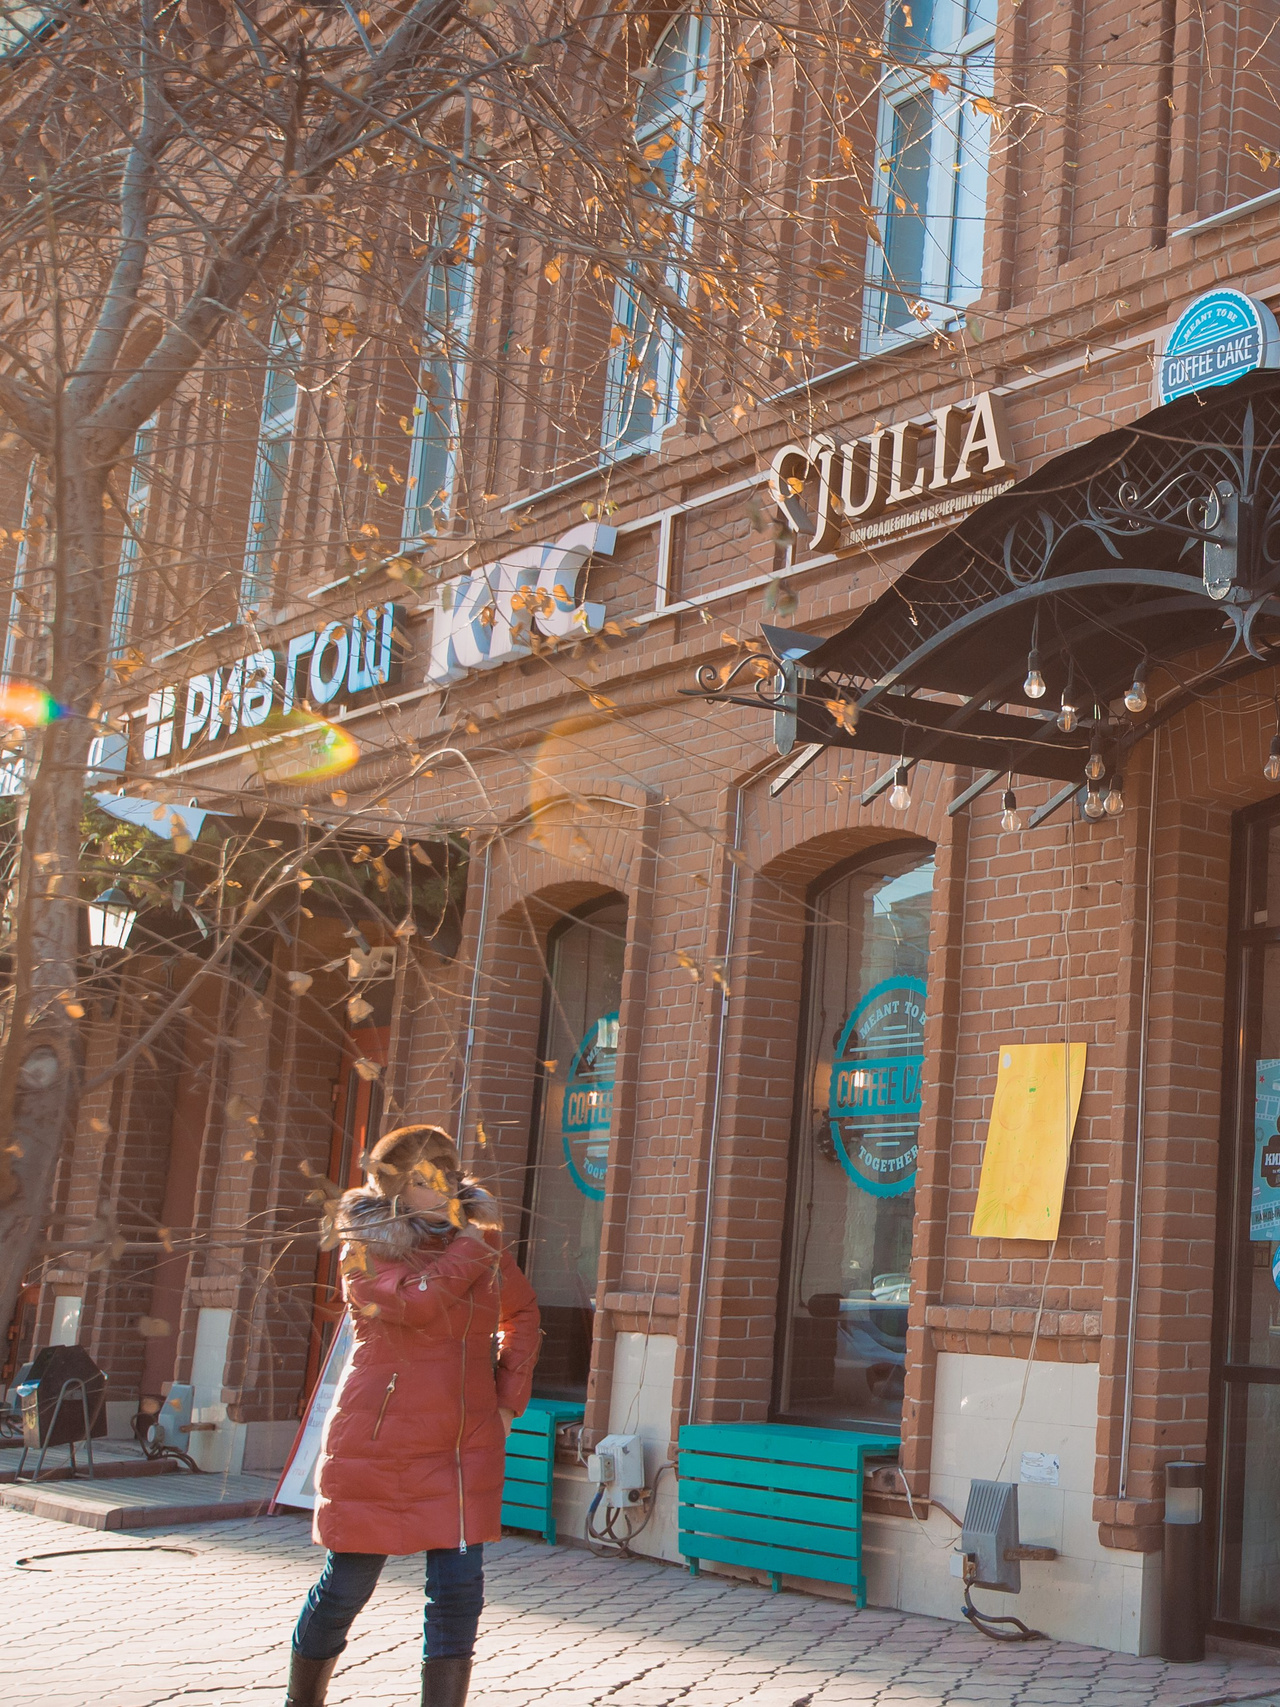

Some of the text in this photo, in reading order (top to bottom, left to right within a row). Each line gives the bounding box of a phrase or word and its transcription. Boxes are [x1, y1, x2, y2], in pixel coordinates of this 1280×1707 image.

[1183, 308, 1238, 340] MEANT TO BE
[1168, 335, 1252, 387] COFFEE CAKE
[770, 391, 1006, 551] JULIA
[866, 511, 921, 540] СВАДЕБНЫХ
[920, 508, 928, 522] И
[928, 495, 973, 520] ВЕЧЕРНИХ
[424, 521, 603, 683] KFC
[860, 1001, 927, 1039] MEANT TO B
[837, 1063, 922, 1108] COFFEE CA
[858, 1144, 919, 1172] TOGETHER
